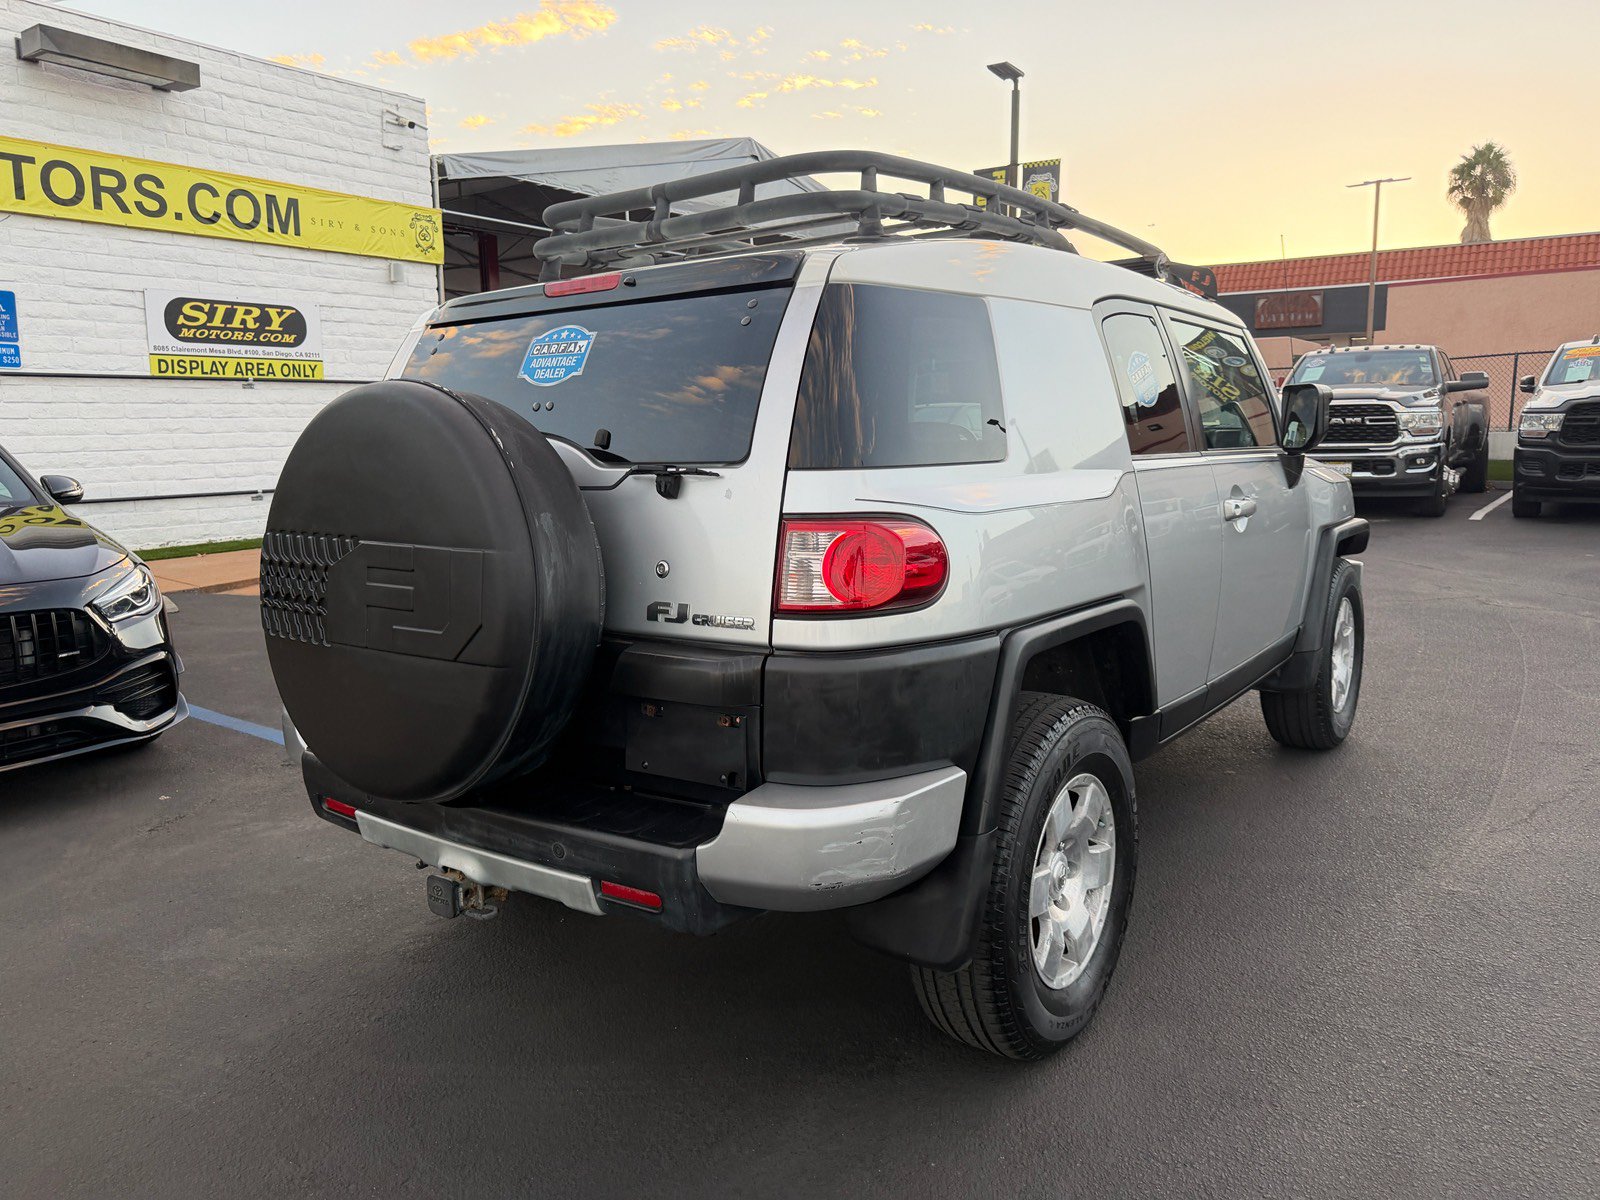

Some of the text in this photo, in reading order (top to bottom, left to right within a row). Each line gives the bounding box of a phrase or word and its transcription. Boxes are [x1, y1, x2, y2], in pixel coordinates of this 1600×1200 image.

[0, 152, 302, 237] TORS.COM
[310, 217, 406, 238] SIRY & SONS
[176, 301, 296, 331] SIRY
[178, 328, 297, 343] MOTORS.COM
[171, 345, 207, 353] Clairemont
[227, 348, 243, 356] Blvd,
[531, 341, 587, 355] CARFAX
[2, 355, 19, 364] $250
[530, 356, 578, 368] ADVANTAGE
[157, 359, 318, 378] DISPLAY AREA ONLY
[534, 368, 566, 379] DEALER
[1329, 417, 1362, 425] AM
[646, 601, 755, 631] FJ CRUISER
